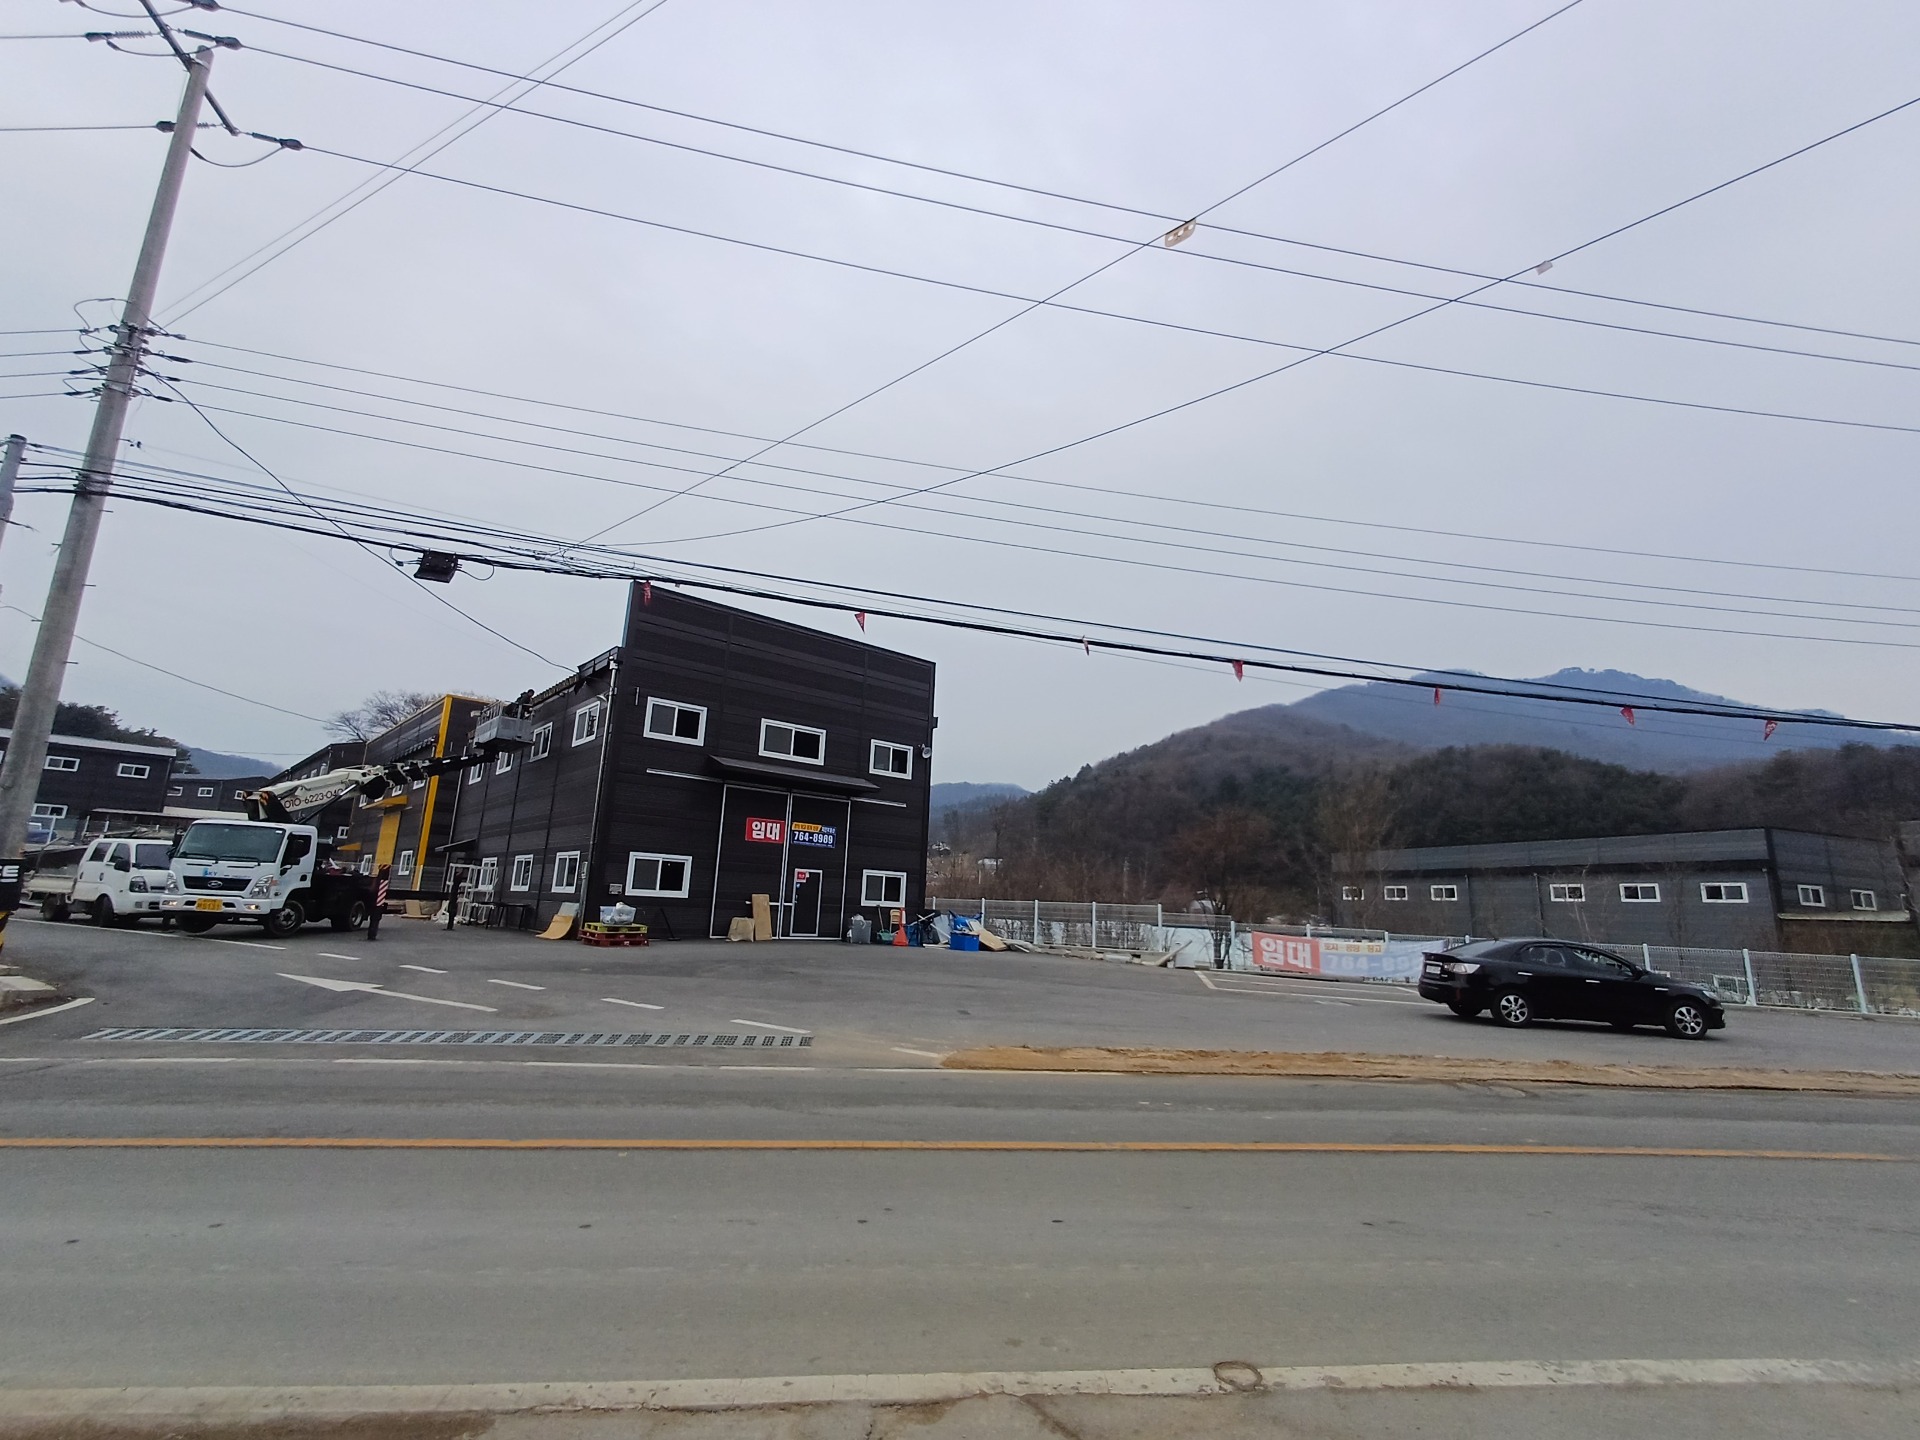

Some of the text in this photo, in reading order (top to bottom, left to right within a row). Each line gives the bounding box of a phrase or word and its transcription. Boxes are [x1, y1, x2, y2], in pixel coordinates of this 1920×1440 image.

[752, 821, 780, 840] 임대
[794, 831, 833, 844] 764-8989
[1260, 938, 1312, 968] 임대
